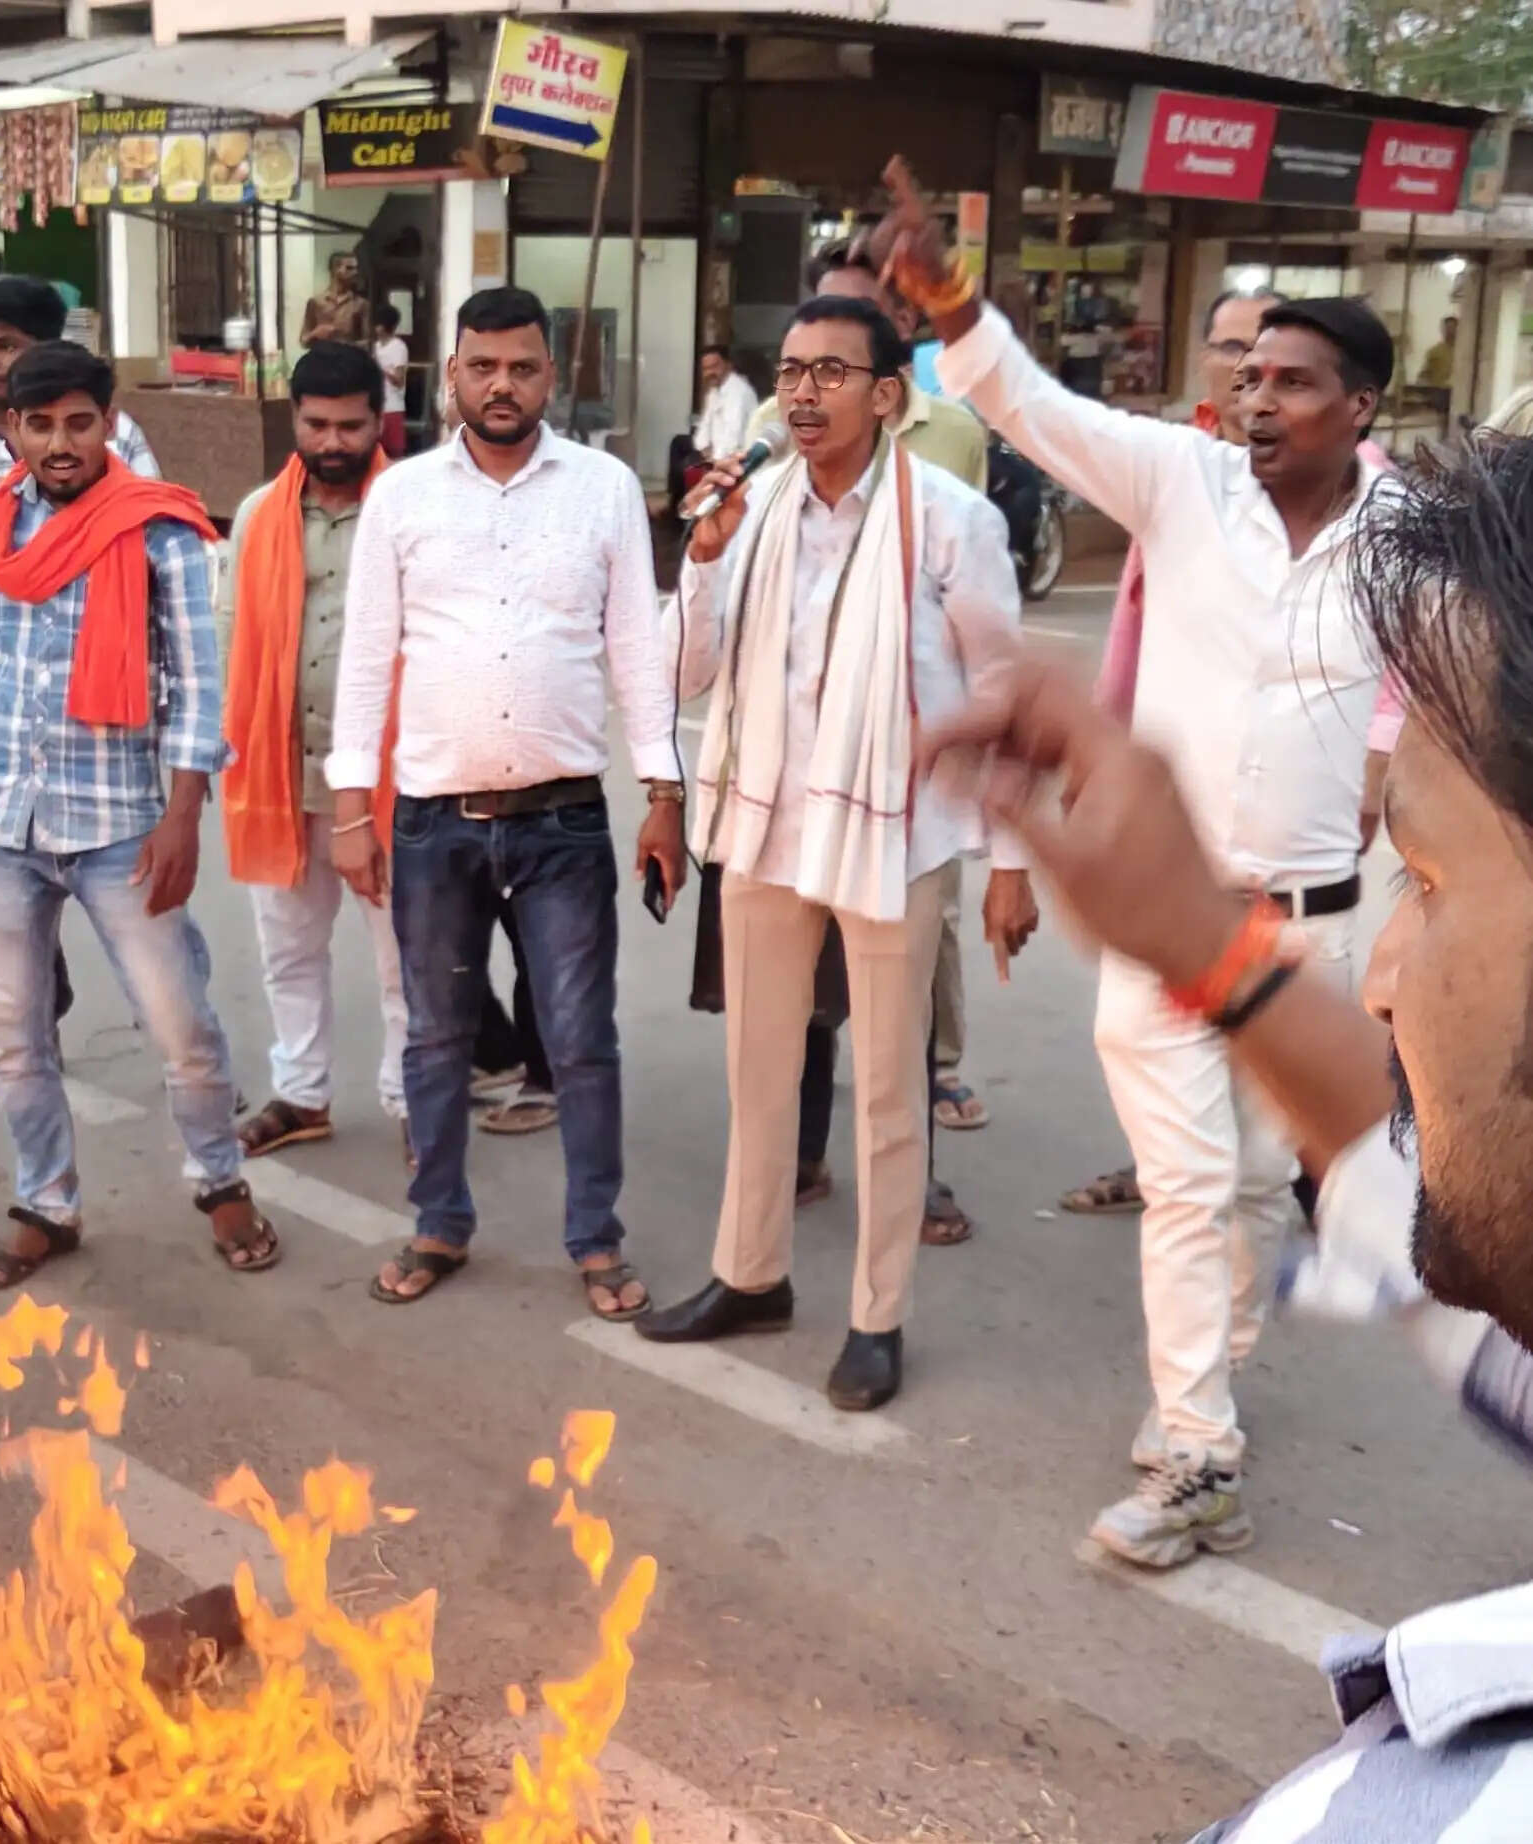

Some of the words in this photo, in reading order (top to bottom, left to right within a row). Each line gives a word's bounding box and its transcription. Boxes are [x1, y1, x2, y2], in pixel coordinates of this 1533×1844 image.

[526, 34, 599, 81] गौरव
[325, 109, 451, 137] Midnight
[352, 142, 416, 167] Café
